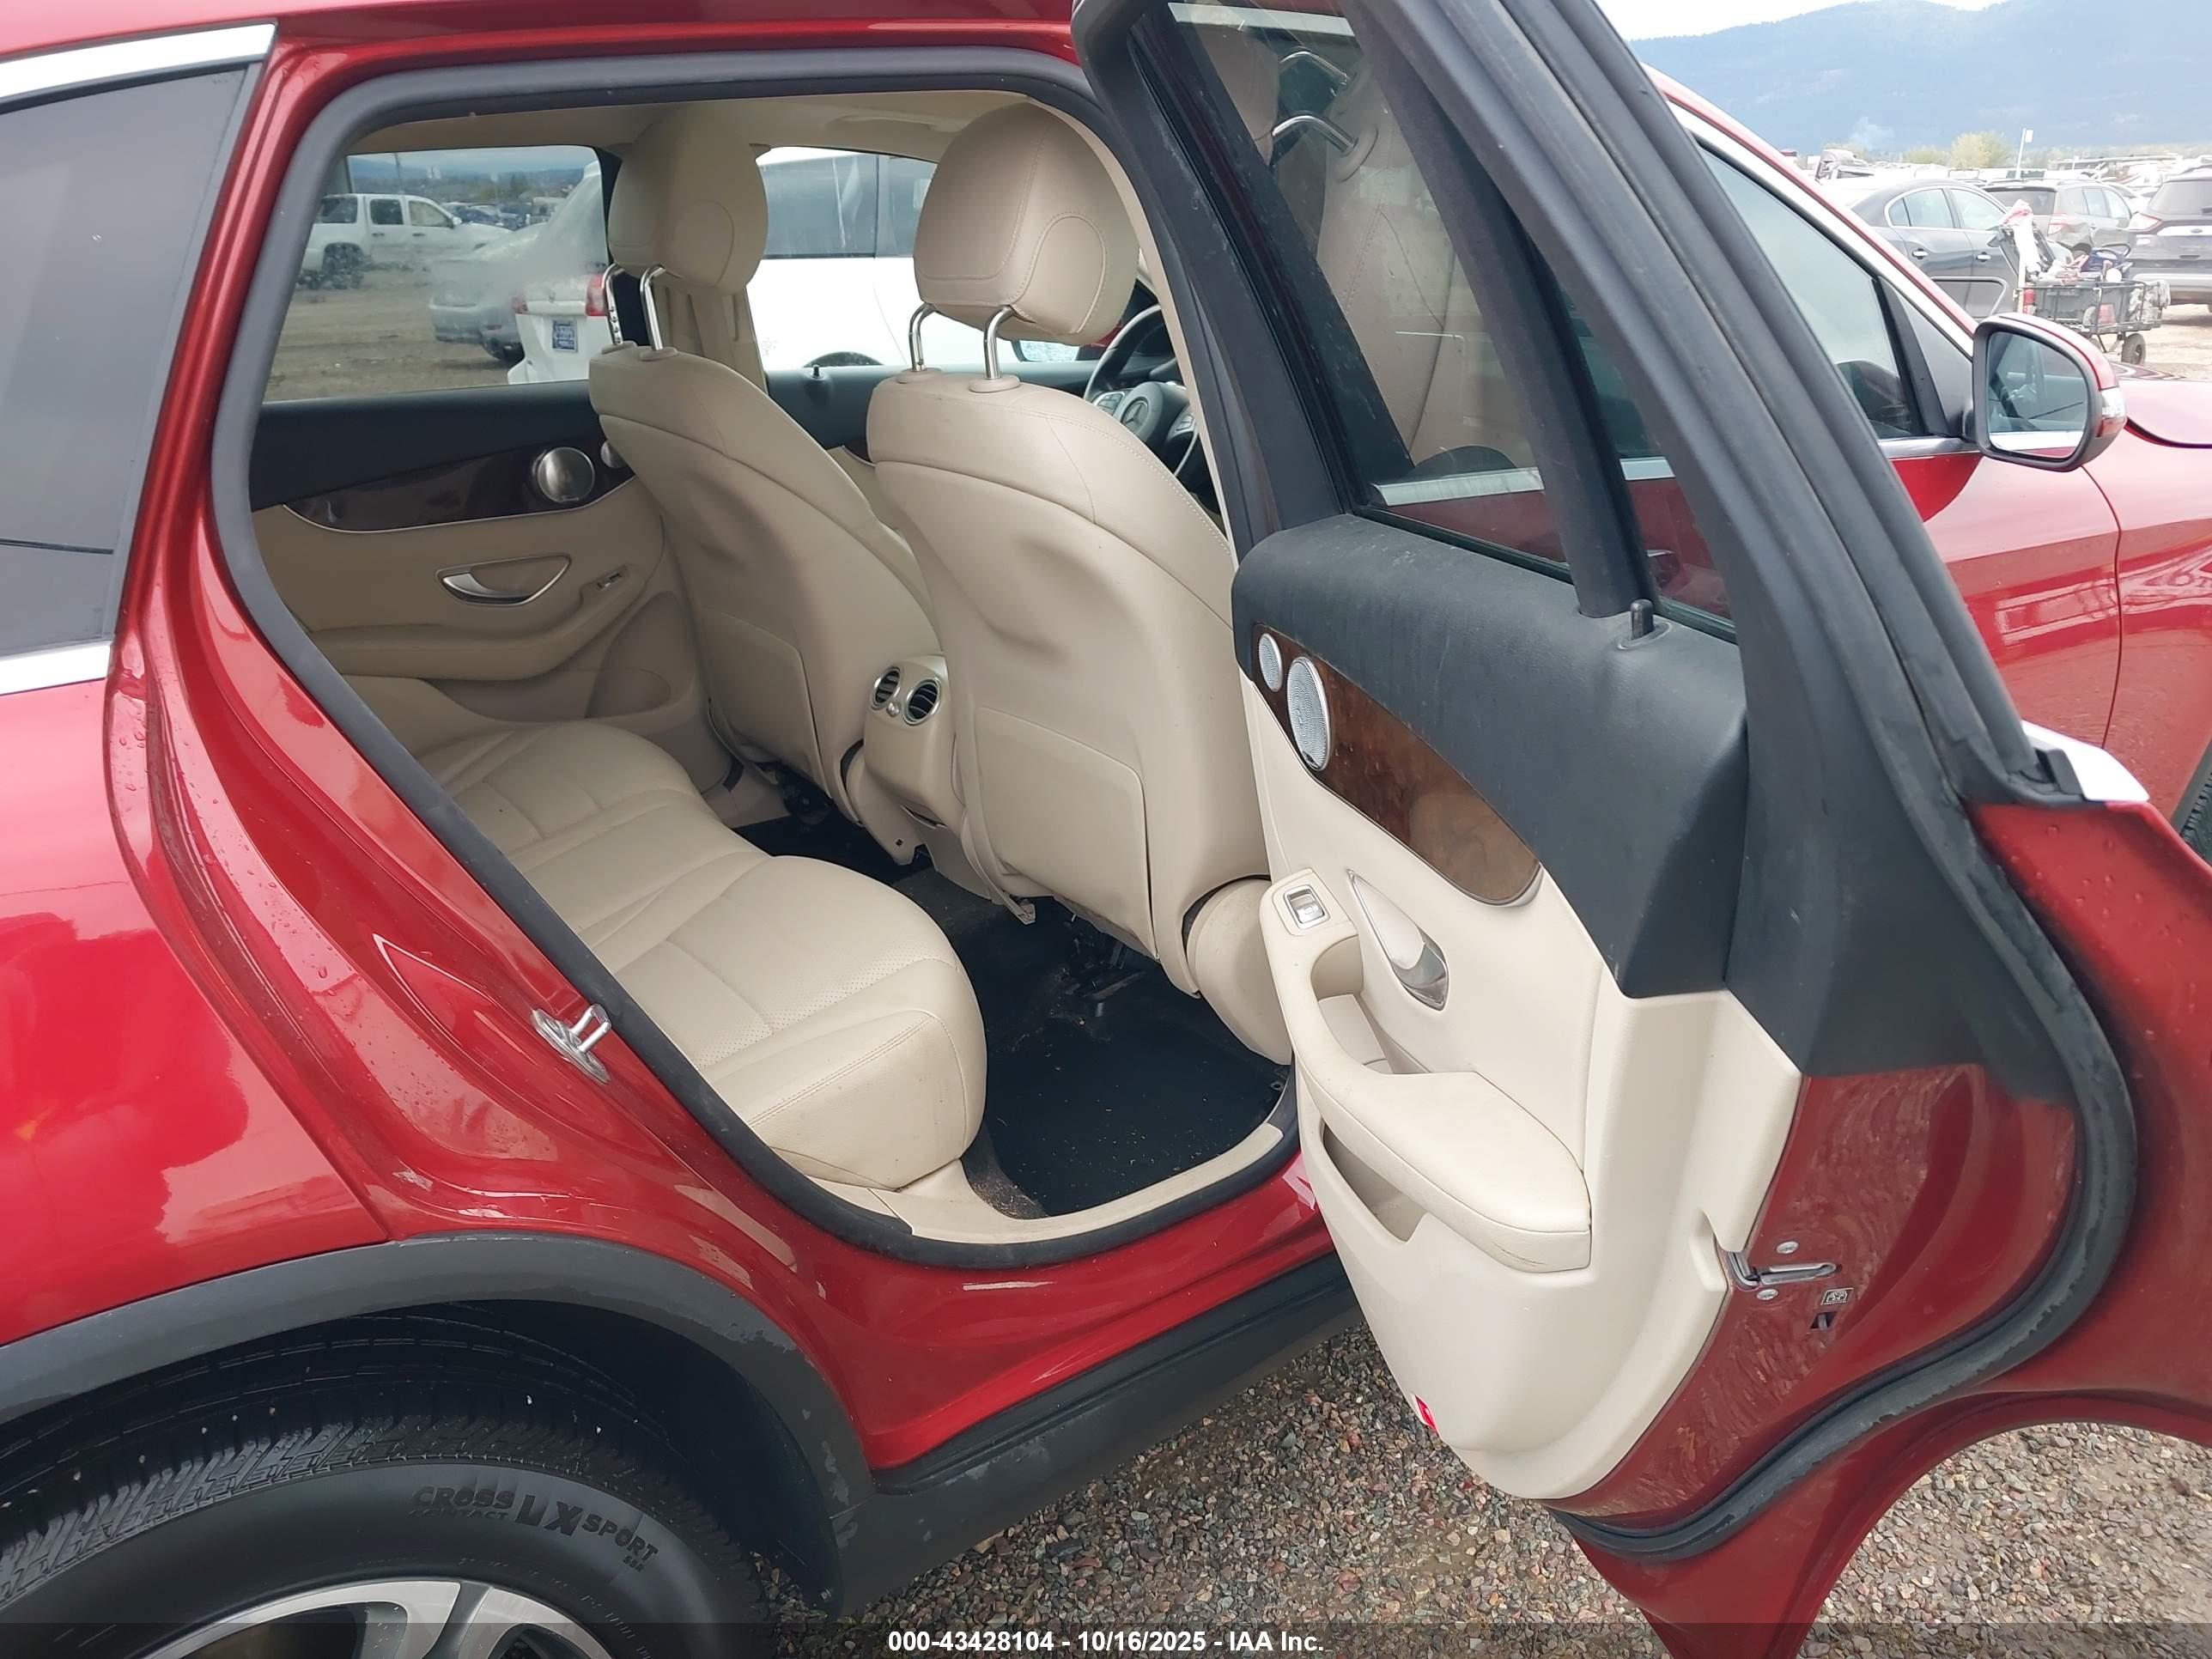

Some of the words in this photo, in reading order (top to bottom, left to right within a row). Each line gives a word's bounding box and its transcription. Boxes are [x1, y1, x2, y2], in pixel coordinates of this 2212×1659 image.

[411, 1486, 516, 1509] CROSS
[515, 1494, 583, 1536] LX
[580, 1514, 659, 1561] SPORT
